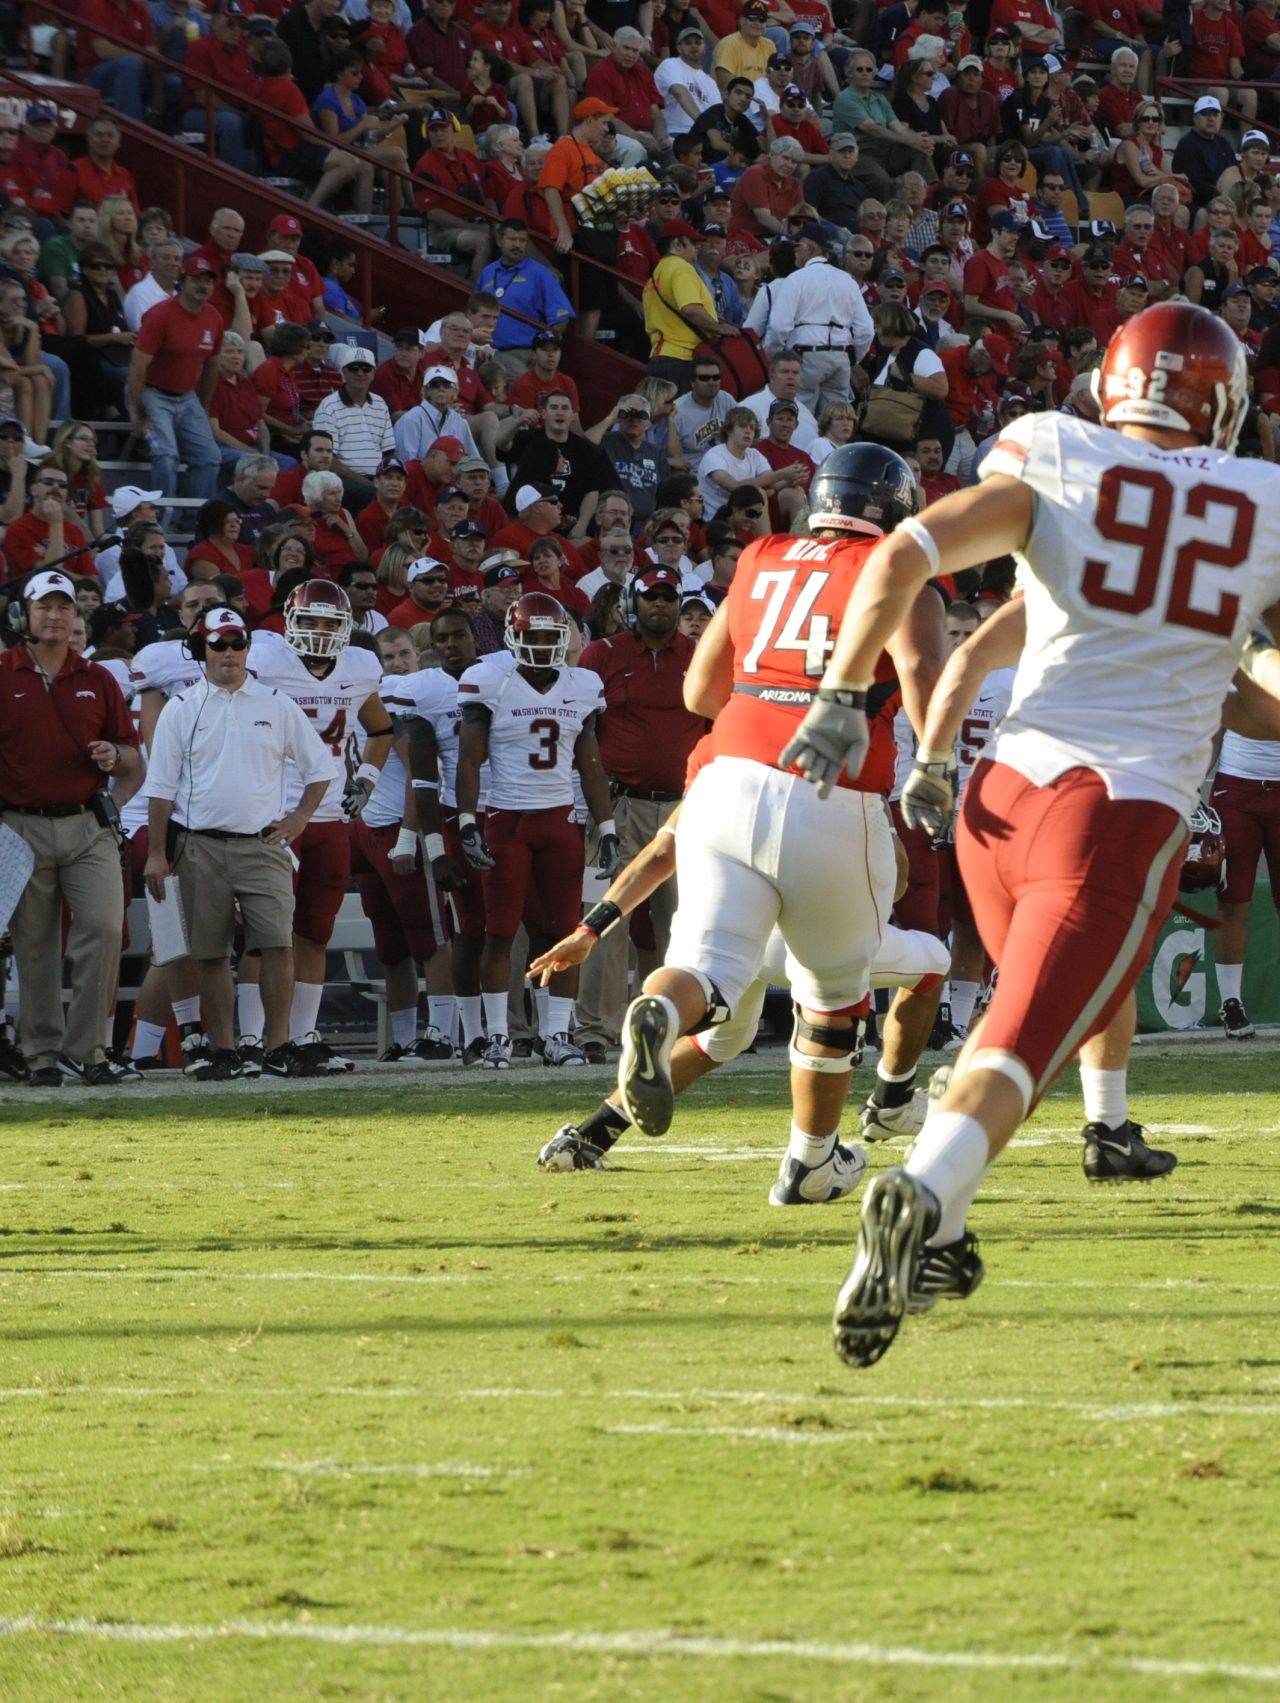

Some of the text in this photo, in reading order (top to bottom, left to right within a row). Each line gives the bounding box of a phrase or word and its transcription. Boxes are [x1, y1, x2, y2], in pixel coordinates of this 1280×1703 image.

[1127, 367, 1168, 402] 92
[1080, 464, 1259, 640] 92
[741, 569, 836, 677] 74
[333, 697, 353, 706] STATE
[511, 707, 578, 719] WASHINGTON STATE
[758, 689, 811, 702] ARIZONA
[528, 718, 560, 770] 3
[960, 718, 991, 766] 5
